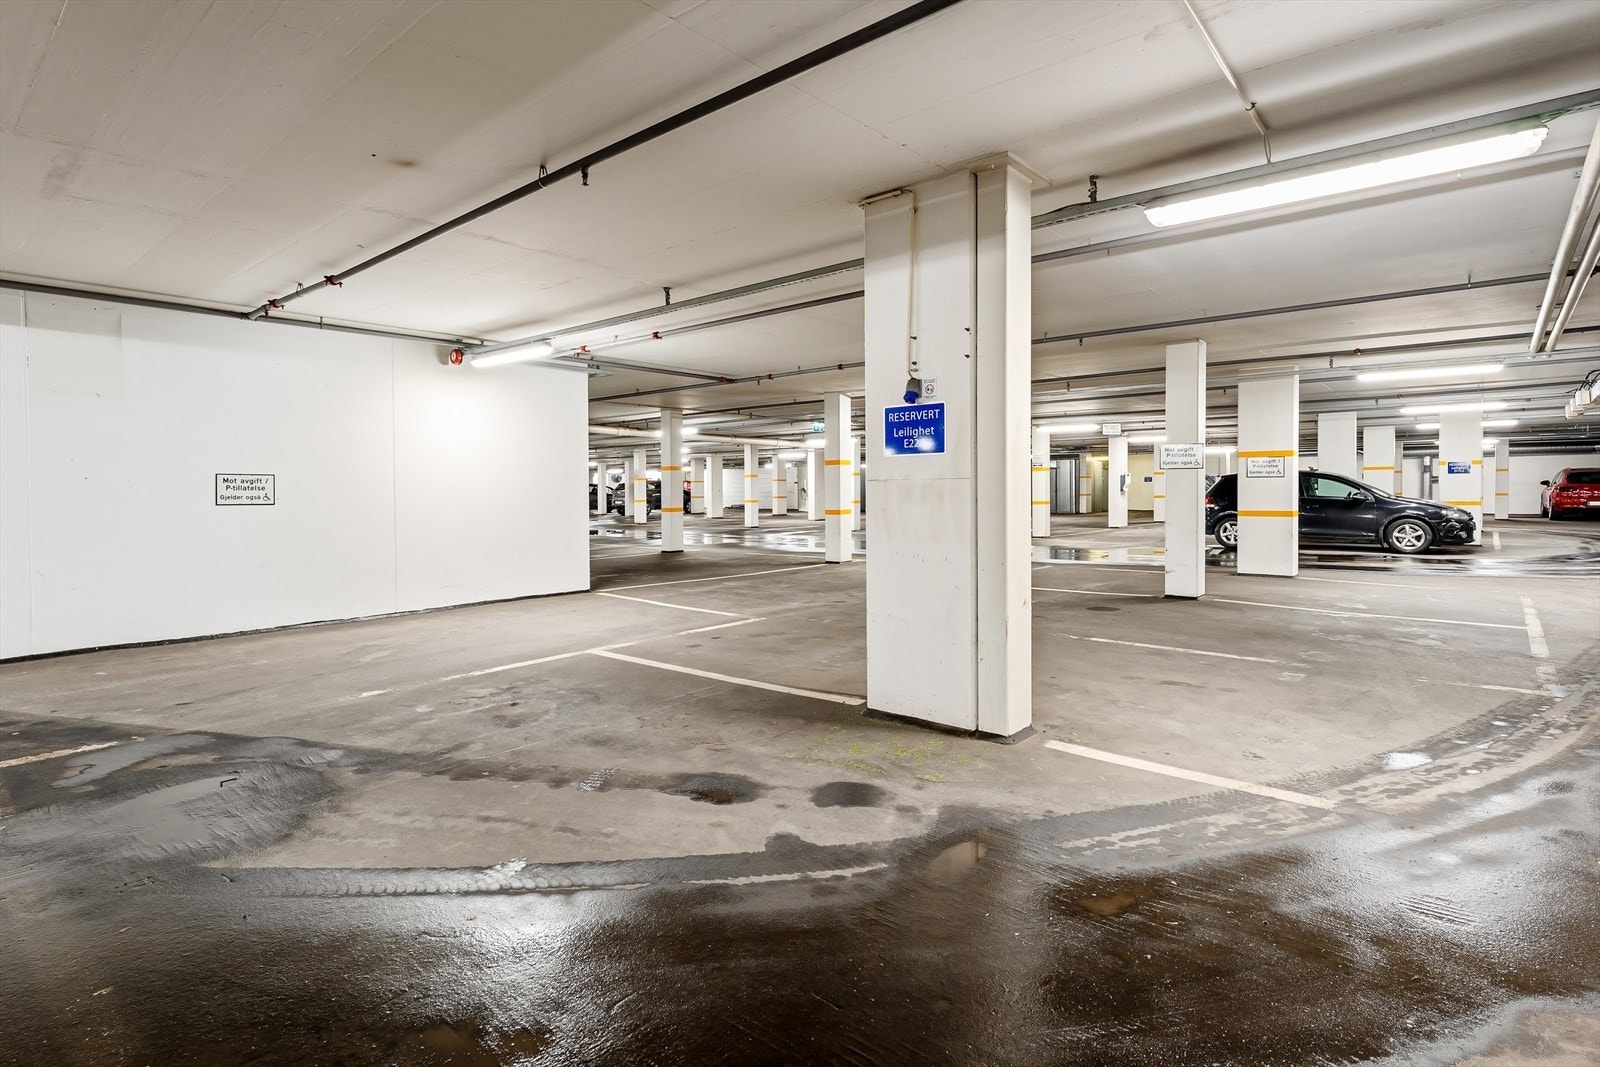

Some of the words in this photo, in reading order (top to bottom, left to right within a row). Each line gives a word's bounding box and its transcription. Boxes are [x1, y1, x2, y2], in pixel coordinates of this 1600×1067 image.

[888, 409, 940, 422] RESERVERT
[893, 426, 935, 438] Leilighet
[240, 477, 262, 485] avgift
